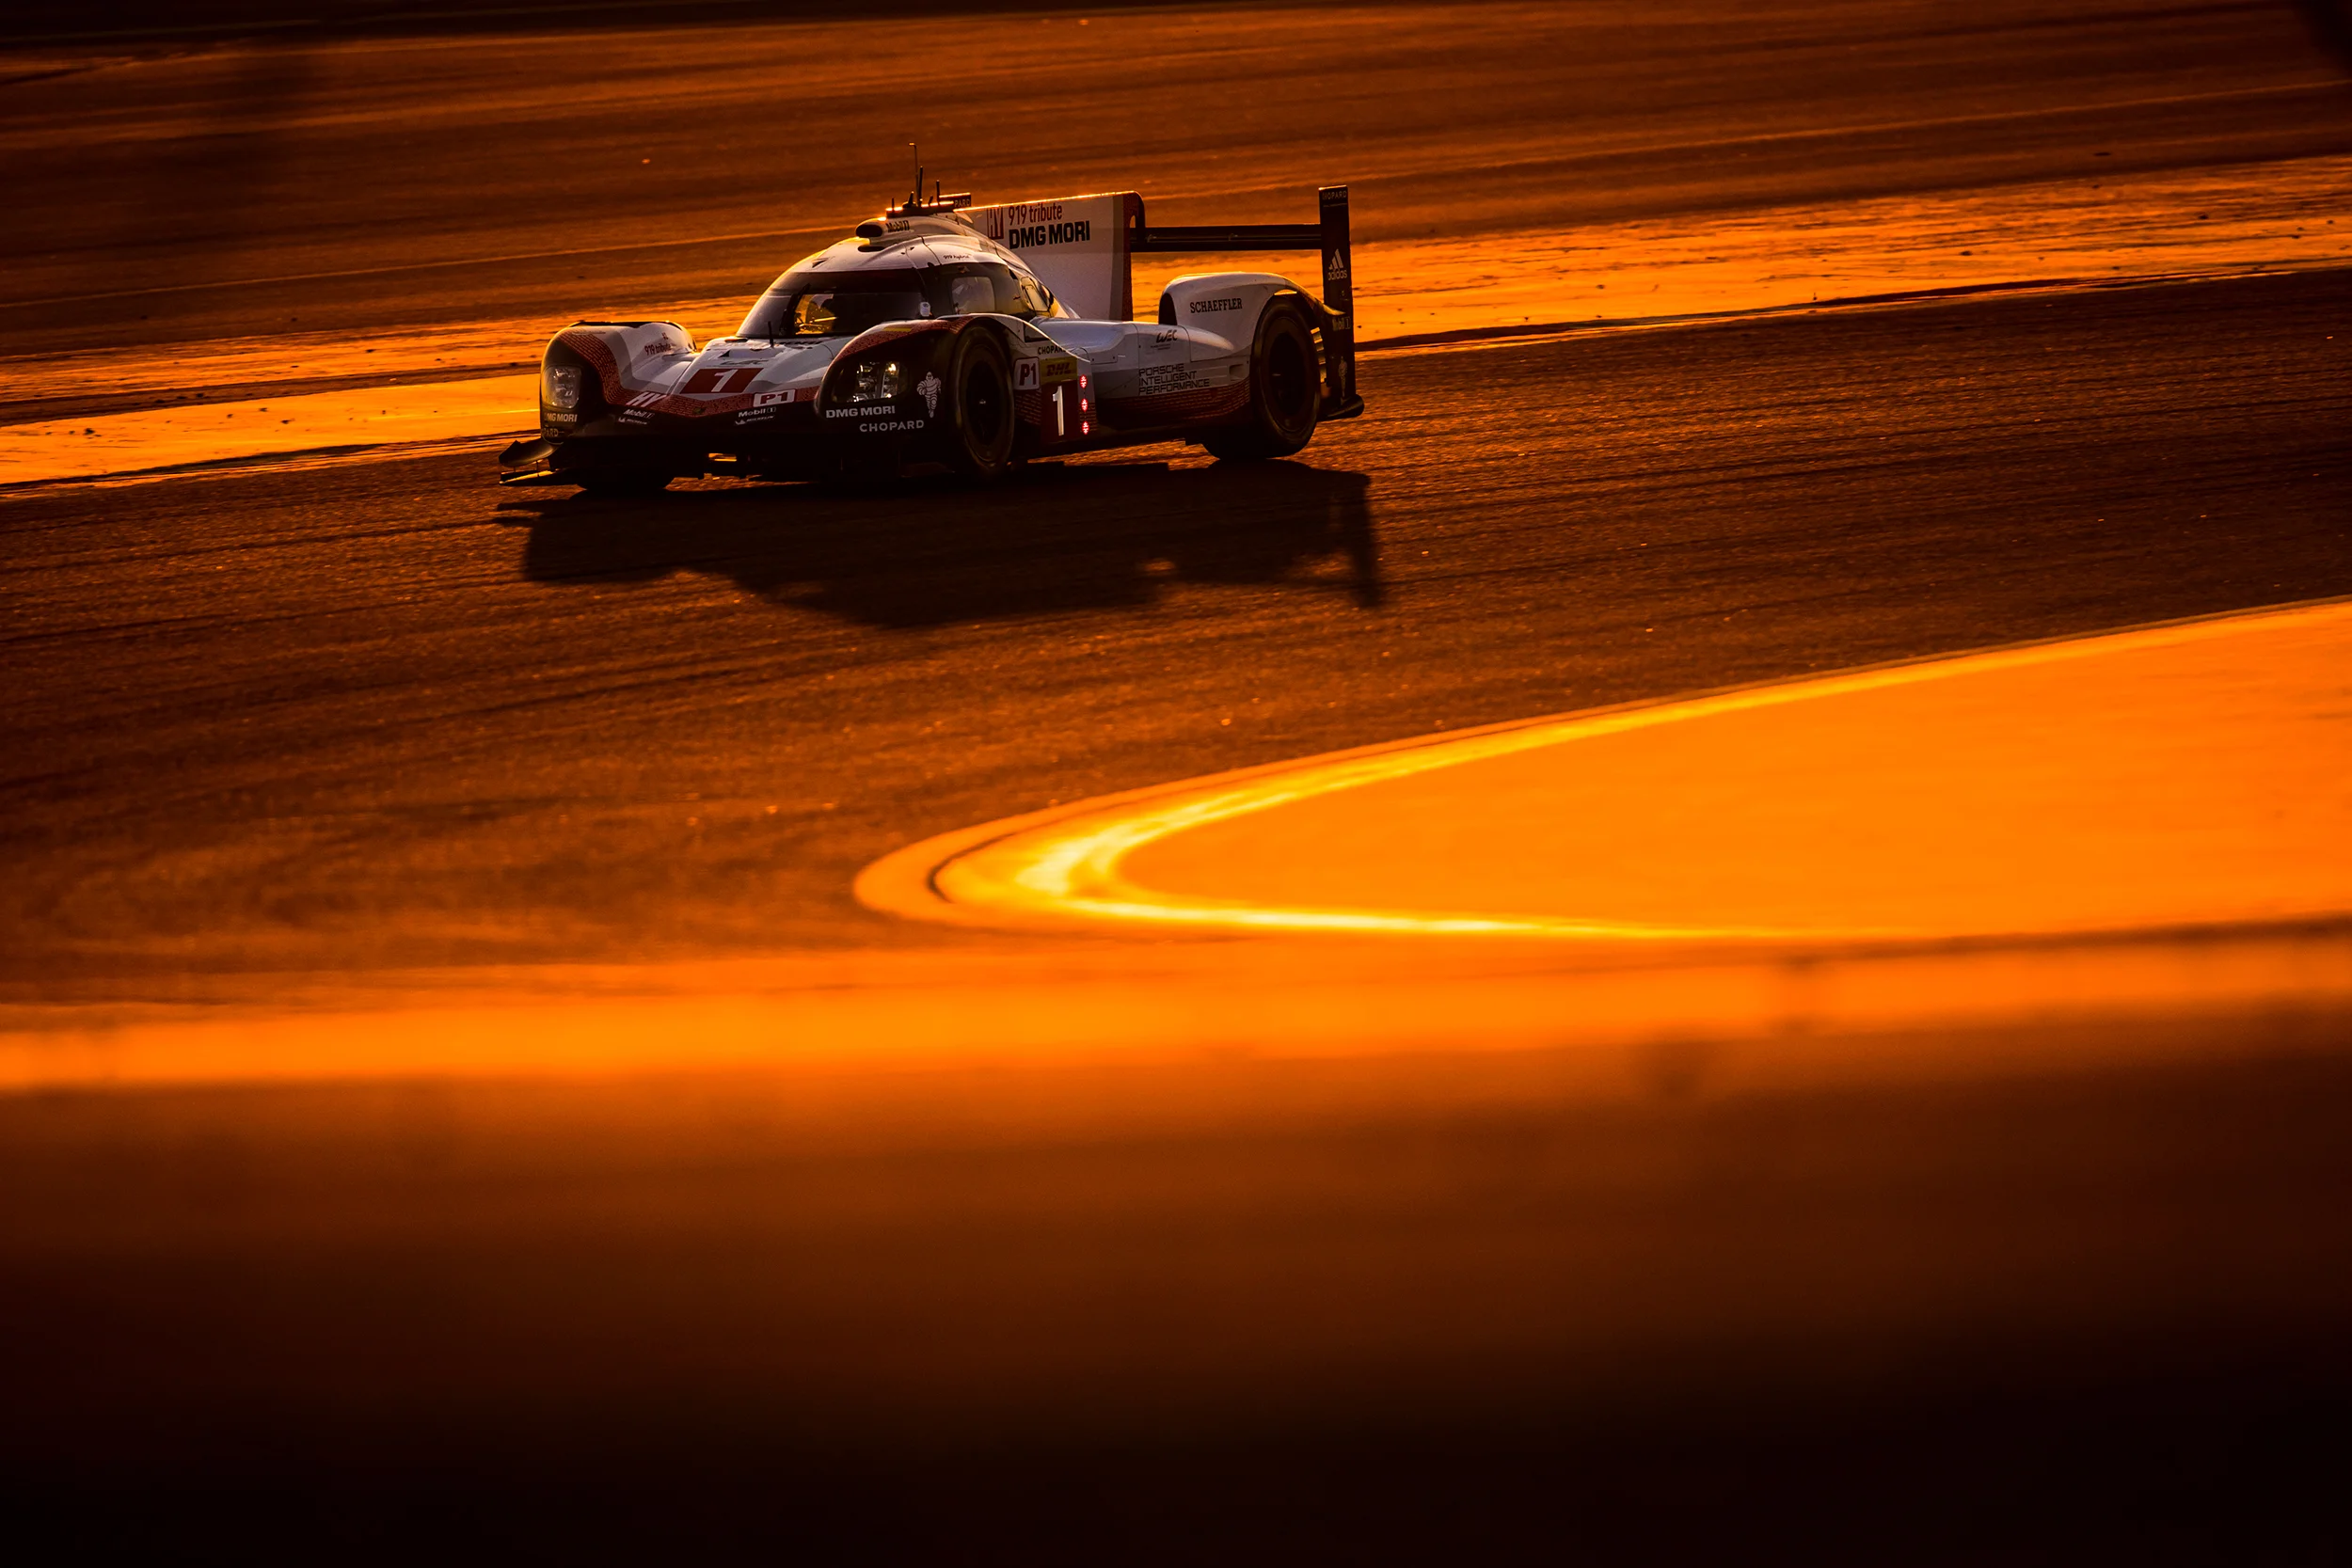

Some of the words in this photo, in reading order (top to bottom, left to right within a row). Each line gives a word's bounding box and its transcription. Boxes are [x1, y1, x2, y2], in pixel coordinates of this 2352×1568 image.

[1009, 205, 1027, 226] 919
[1029, 202, 1063, 223] tribute
[1009, 226, 1046, 249] DMG
[1049, 221, 1090, 244] MORI
[1327, 270, 1347, 280] adidas
[1189, 297, 1243, 313] SCHAEFFLER
[1156, 329, 1178, 343] WEC
[1038, 345, 1067, 355] CHOPAR
[1019, 363, 1037, 386] P1
[1046, 362, 1072, 376] DHL
[1138, 363, 1184, 376] PORSCHE
[710, 369, 739, 393] 1
[1138, 371, 1198, 387] INTELLIGENT
[1138, 378, 1210, 396] PERFORMANCE
[626, 391, 667, 407] HY
[759, 391, 788, 404] P1
[738, 408, 766, 418] Mobil
[825, 407, 858, 419] DMG
[860, 405, 896, 416] MORI
[1052, 385, 1064, 436] 1
[557, 414, 578, 422] MORI
[859, 420, 925, 433] CHOPARD
